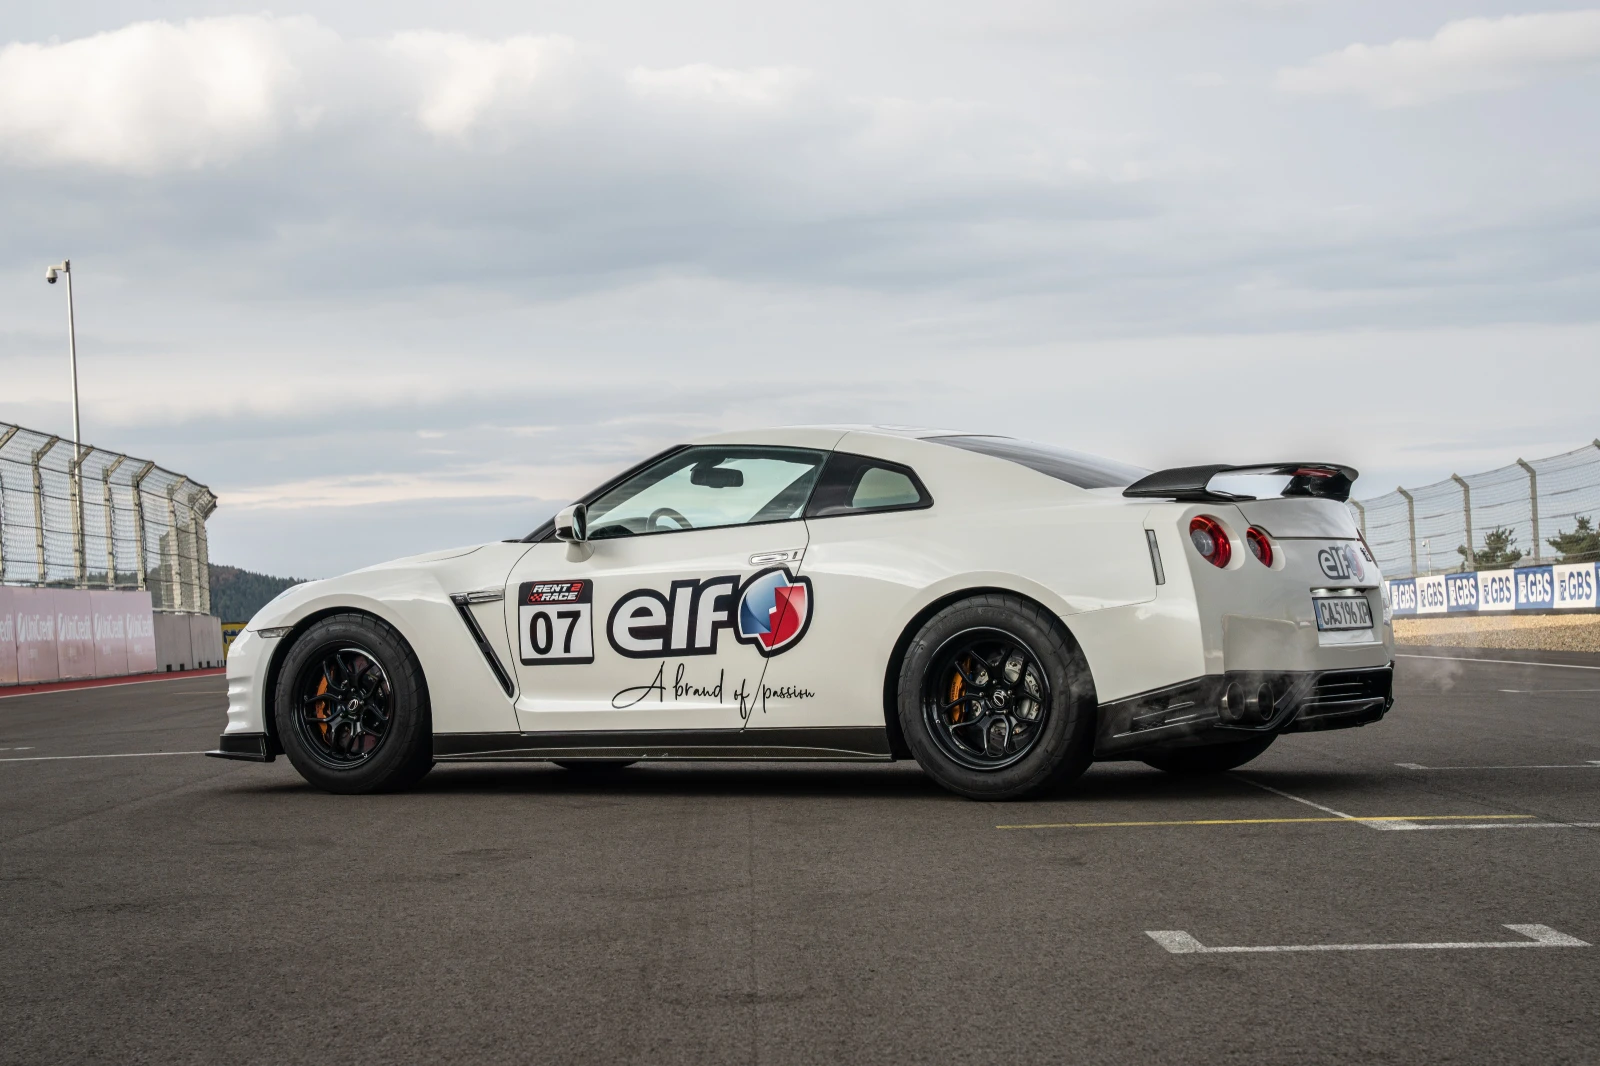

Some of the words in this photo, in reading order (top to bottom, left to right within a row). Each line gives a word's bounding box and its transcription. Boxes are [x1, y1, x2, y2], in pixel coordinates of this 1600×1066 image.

[1318, 547, 1350, 580] elf
[541, 592, 578, 601] RACE
[1399, 584, 1415, 609] GBS
[1427, 582, 1444, 607] GBS
[1456, 578, 1476, 605] GBS
[1491, 576, 1511, 603] GBS
[1528, 572, 1551, 602] GBS
[1568, 570, 1592, 600] GBS
[609, 577, 738, 656] elf
[529, 610, 581, 655] 07
[611, 661, 666, 709] A
[672, 662, 724, 704] brand
[733, 679, 750, 719] of
[762, 684, 815, 713] passion
